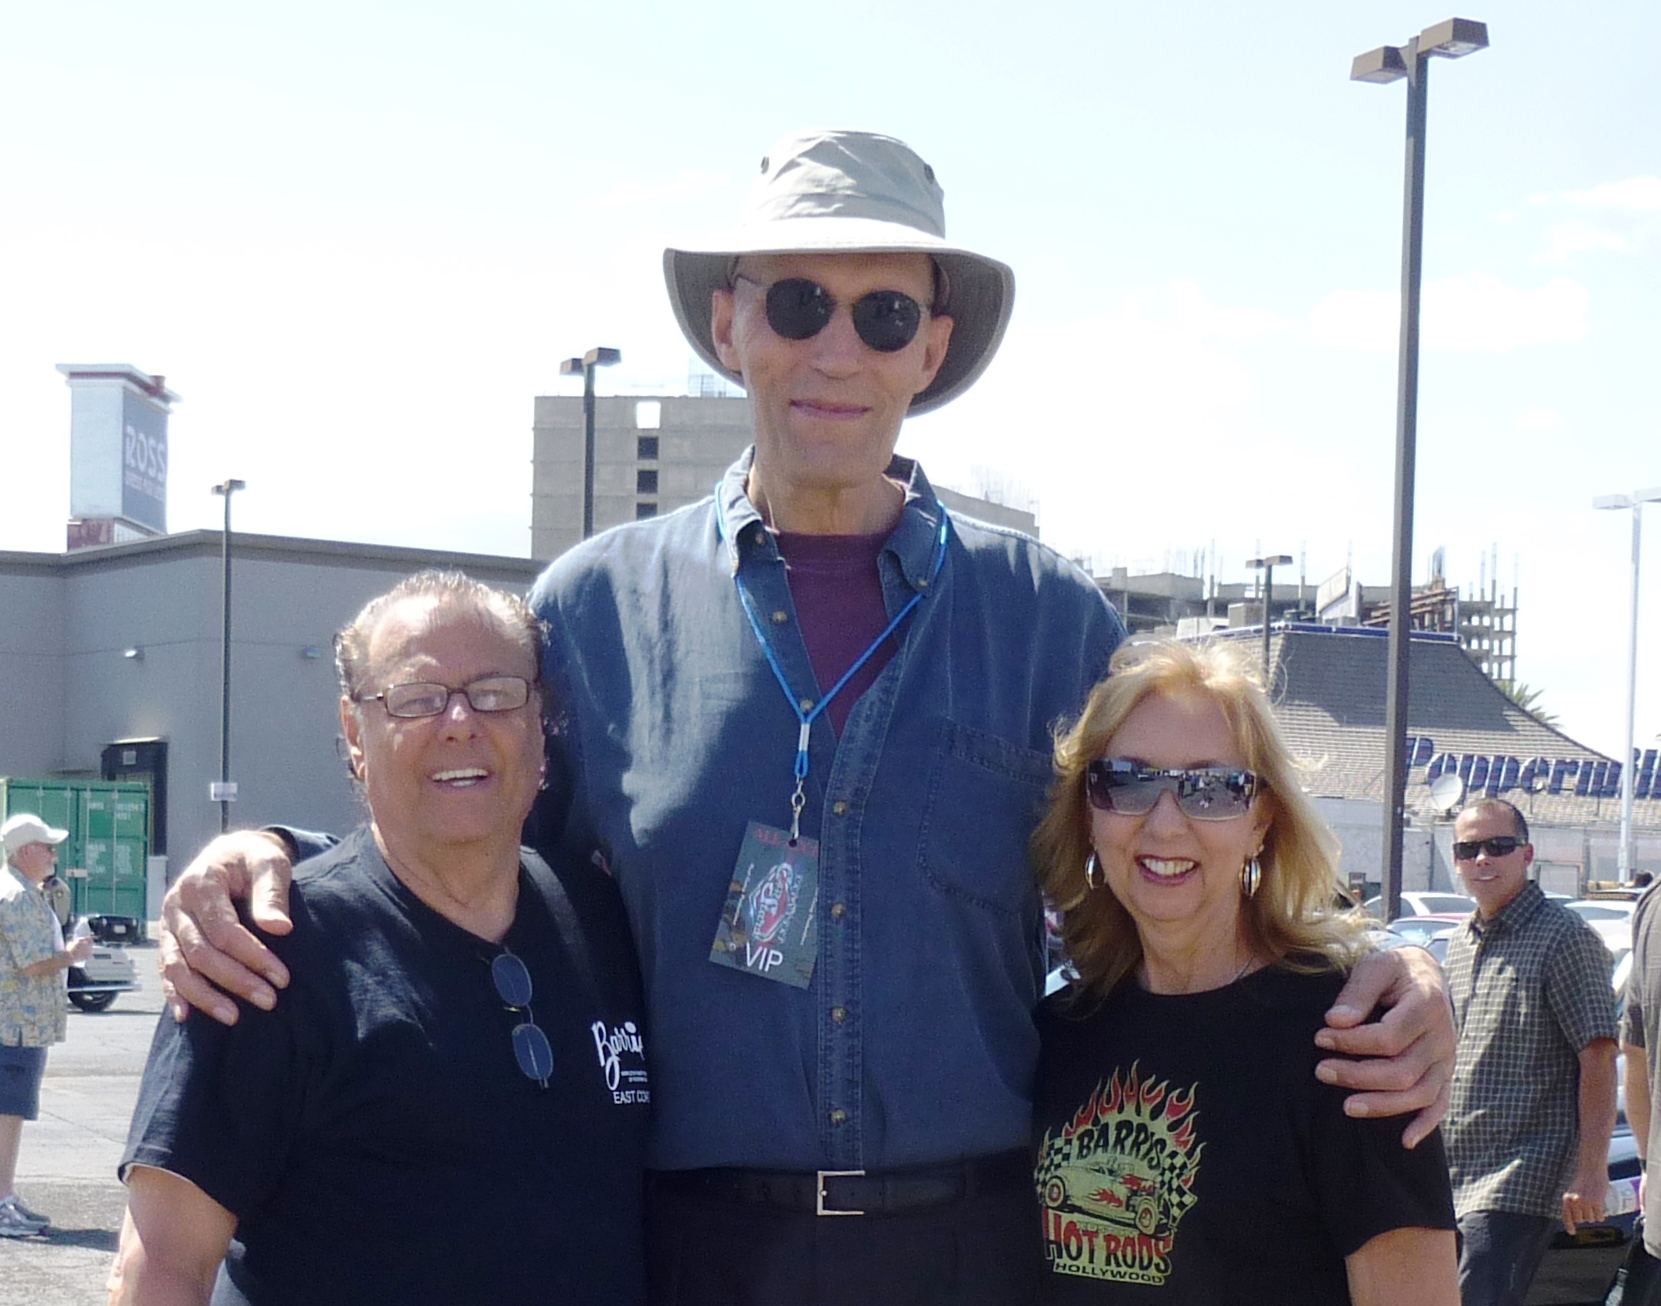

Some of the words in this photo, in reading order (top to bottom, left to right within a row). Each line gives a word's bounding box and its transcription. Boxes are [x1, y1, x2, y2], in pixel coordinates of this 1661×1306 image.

[126, 425, 166, 481] ROSS
[746, 942, 783, 972] VIP
[613, 1090, 636, 1104] EAST
[1077, 1120, 1167, 1170] BARRIS
[1042, 1206, 1099, 1264] HOT
[1103, 1232, 1172, 1274] RODS
[1055, 1263, 1163, 1284] HOLLYWOOD
